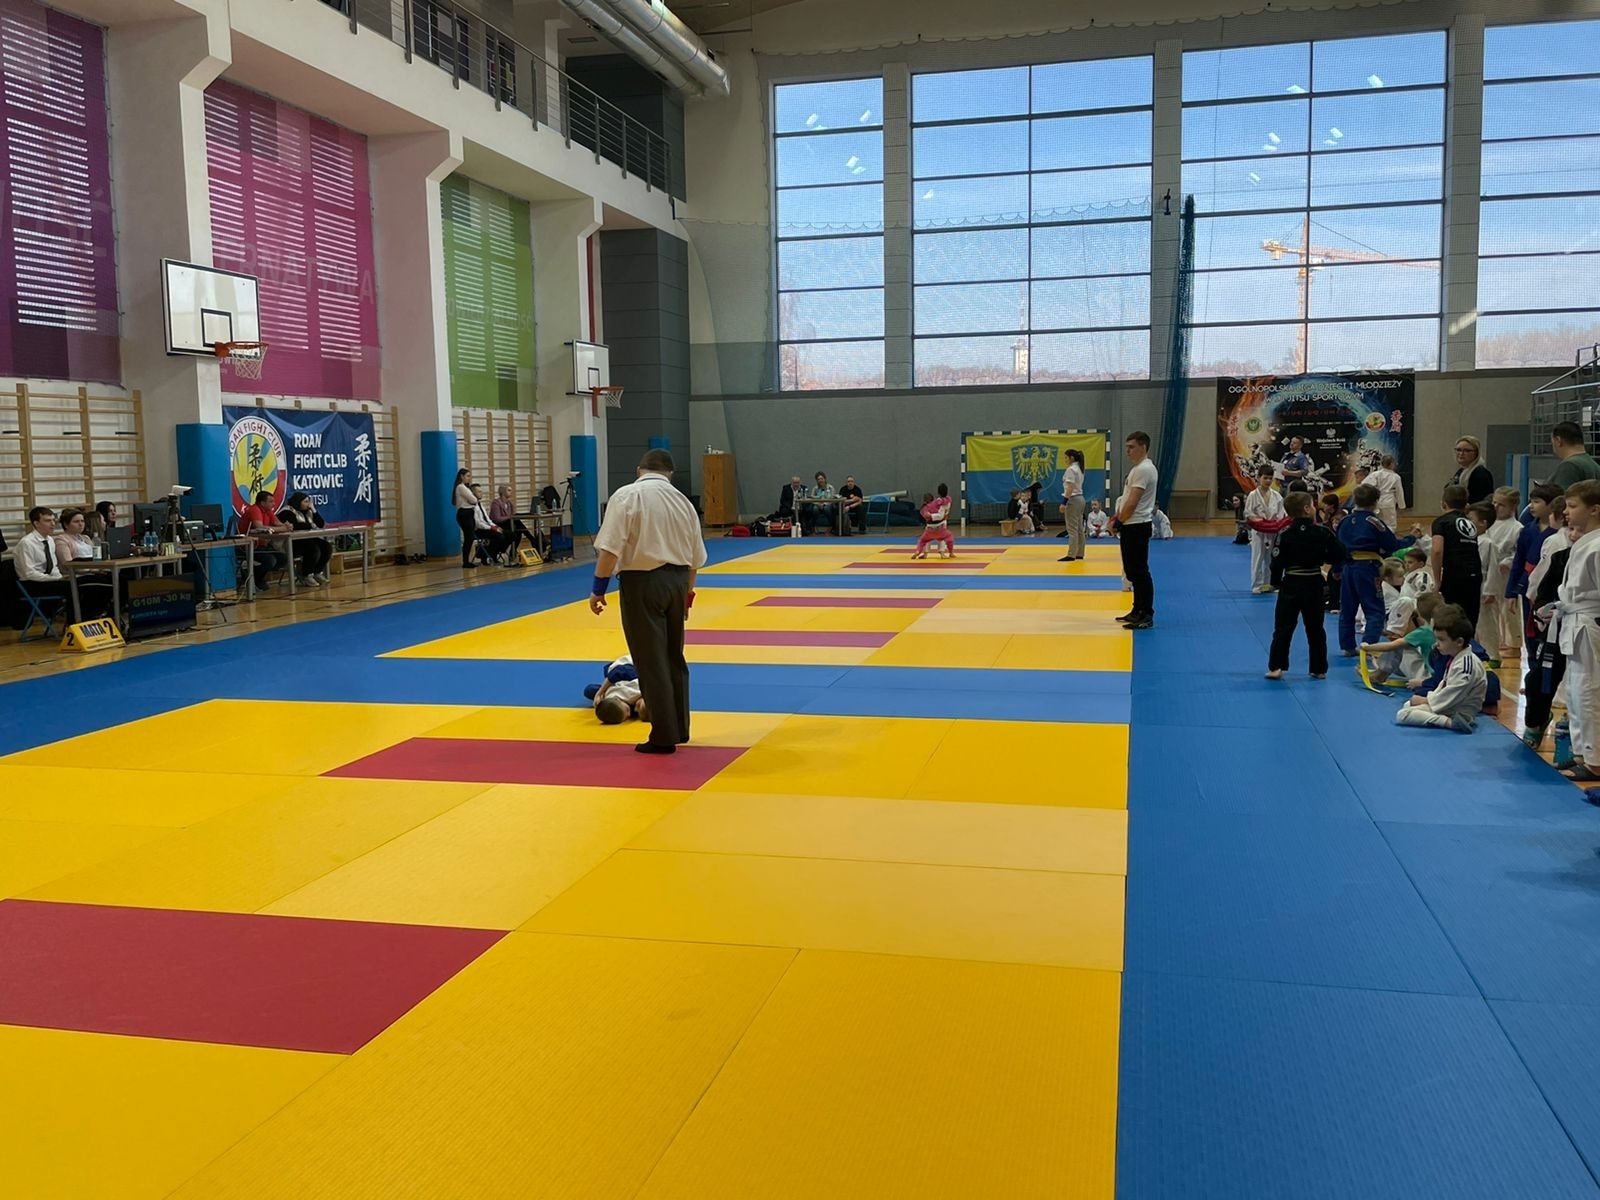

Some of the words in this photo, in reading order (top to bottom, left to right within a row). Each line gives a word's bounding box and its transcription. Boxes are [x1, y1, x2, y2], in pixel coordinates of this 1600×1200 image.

[1287, 394, 1310, 402] JITSU
[243, 421, 267, 434] FIGHT
[267, 431, 281, 458] CLUB
[294, 454, 322, 469] FIGHT
[80, 622, 106, 638] MATA
[104, 620, 118, 640] 2
[66, 632, 75, 646] 2
